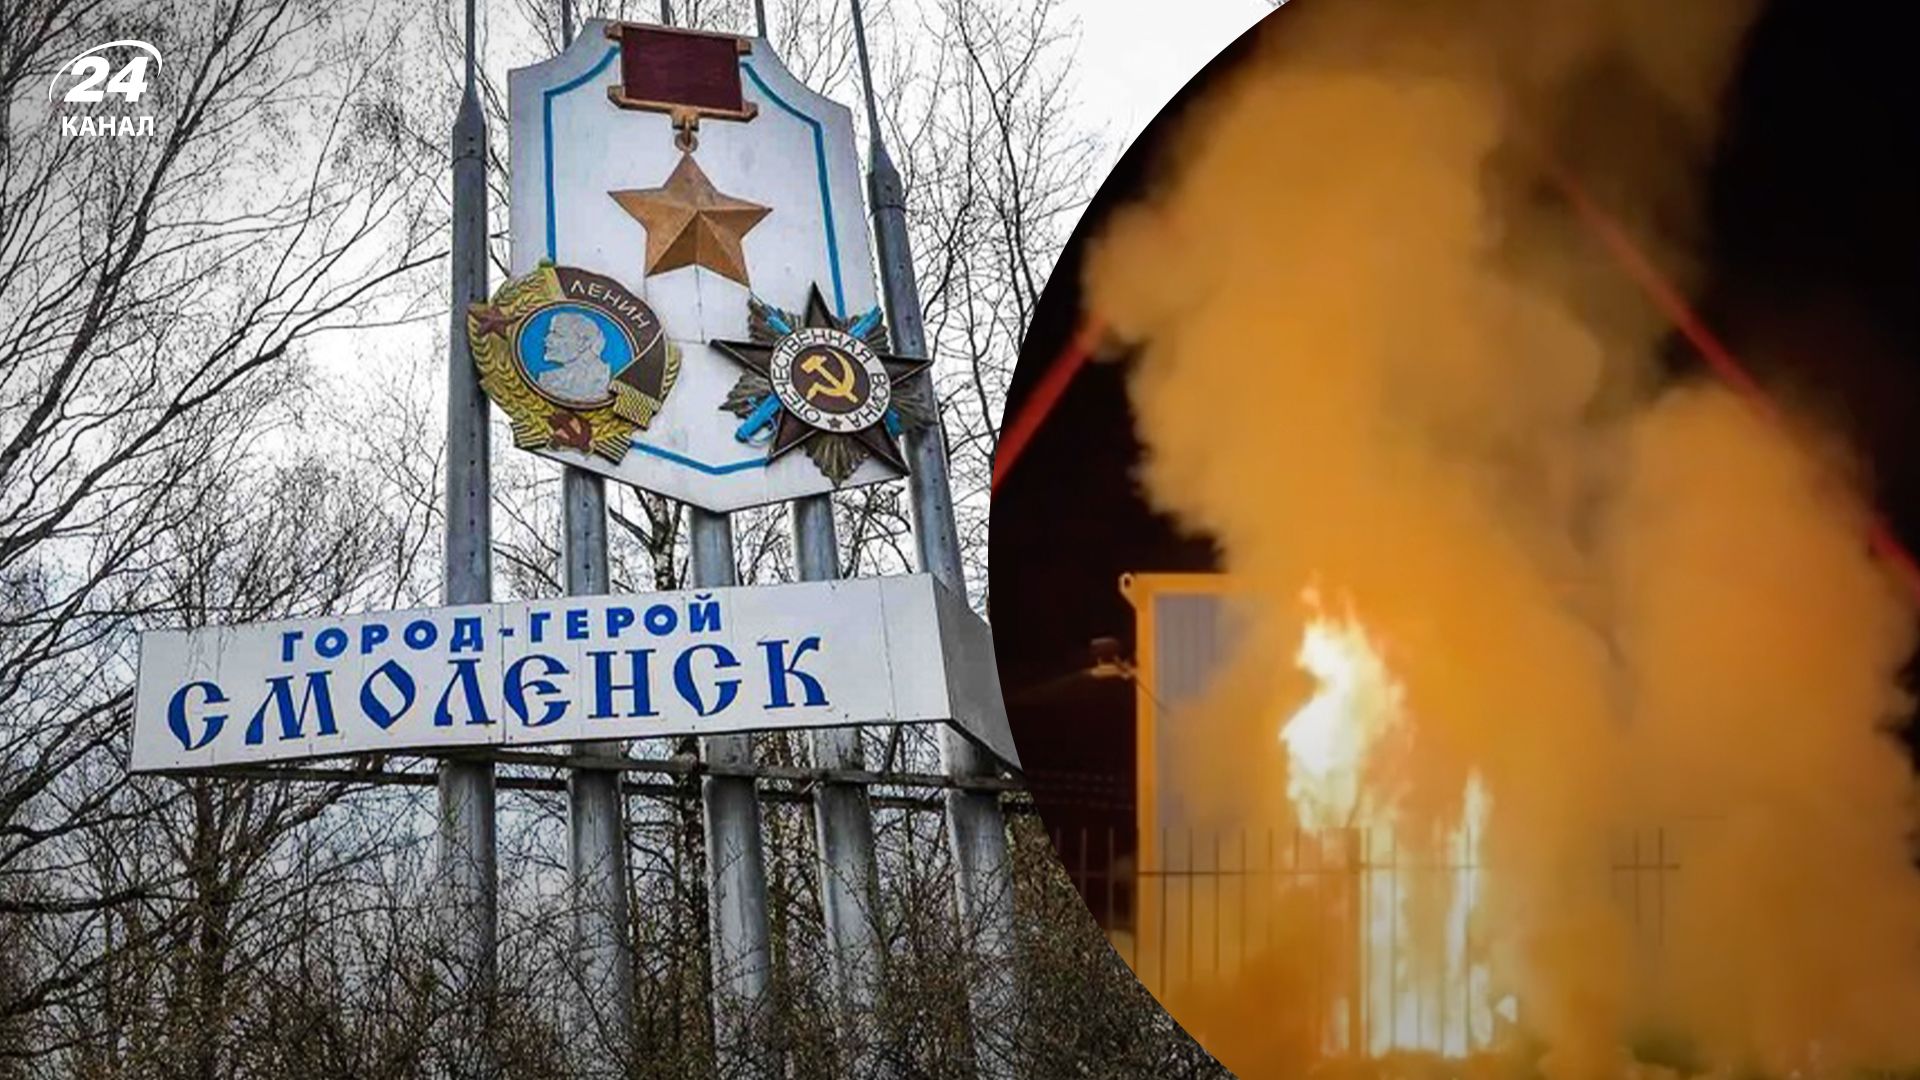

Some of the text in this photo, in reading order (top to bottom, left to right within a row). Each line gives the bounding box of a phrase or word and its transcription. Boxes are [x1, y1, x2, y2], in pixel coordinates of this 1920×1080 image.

[570, 279, 651, 329] ЛЕНИН
[282, 594, 722, 662] ГОРОД-ГЕРОЙ
[168, 637, 829, 750] СМОЛЕНСК
